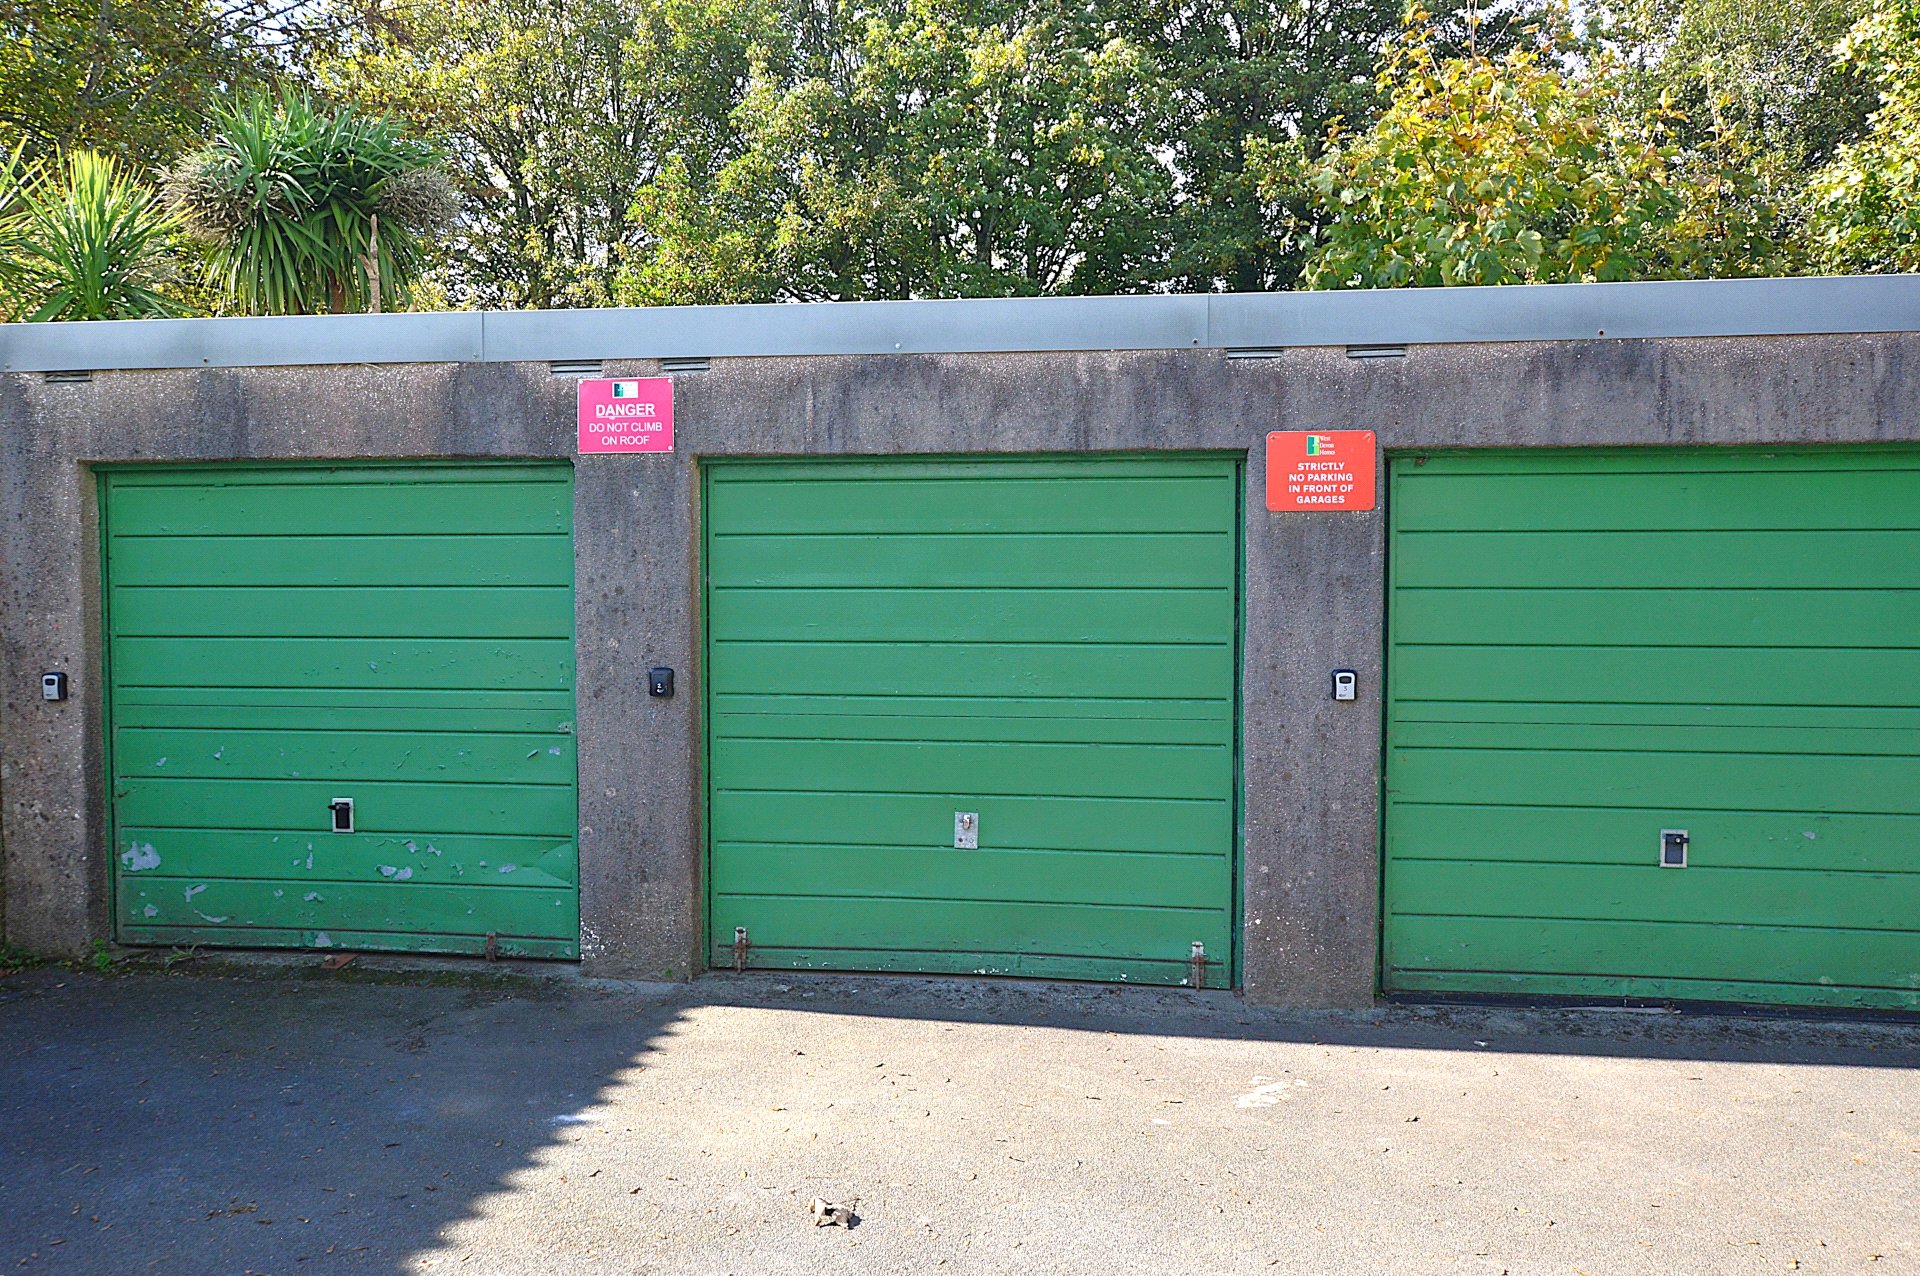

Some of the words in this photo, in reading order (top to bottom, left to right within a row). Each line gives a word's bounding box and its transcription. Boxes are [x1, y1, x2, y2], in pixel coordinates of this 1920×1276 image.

[596, 403, 656, 416] DANGER
[589, 423, 604, 432] DO
[607, 422, 628, 432] NOT
[631, 422, 662, 432] CLIMB
[602, 436, 616, 446] ON
[620, 436, 650, 445] ROOF
[1297, 462, 1344, 470] STRICTLY
[1288, 474, 1304, 482] NO
[1308, 473, 1353, 482] PARKING
[1288, 484, 1300, 492] IN
[1304, 484, 1338, 492] FRONT
[1340, 484, 1354, 492] OF
[1296, 496, 1345, 504] GARAGES
